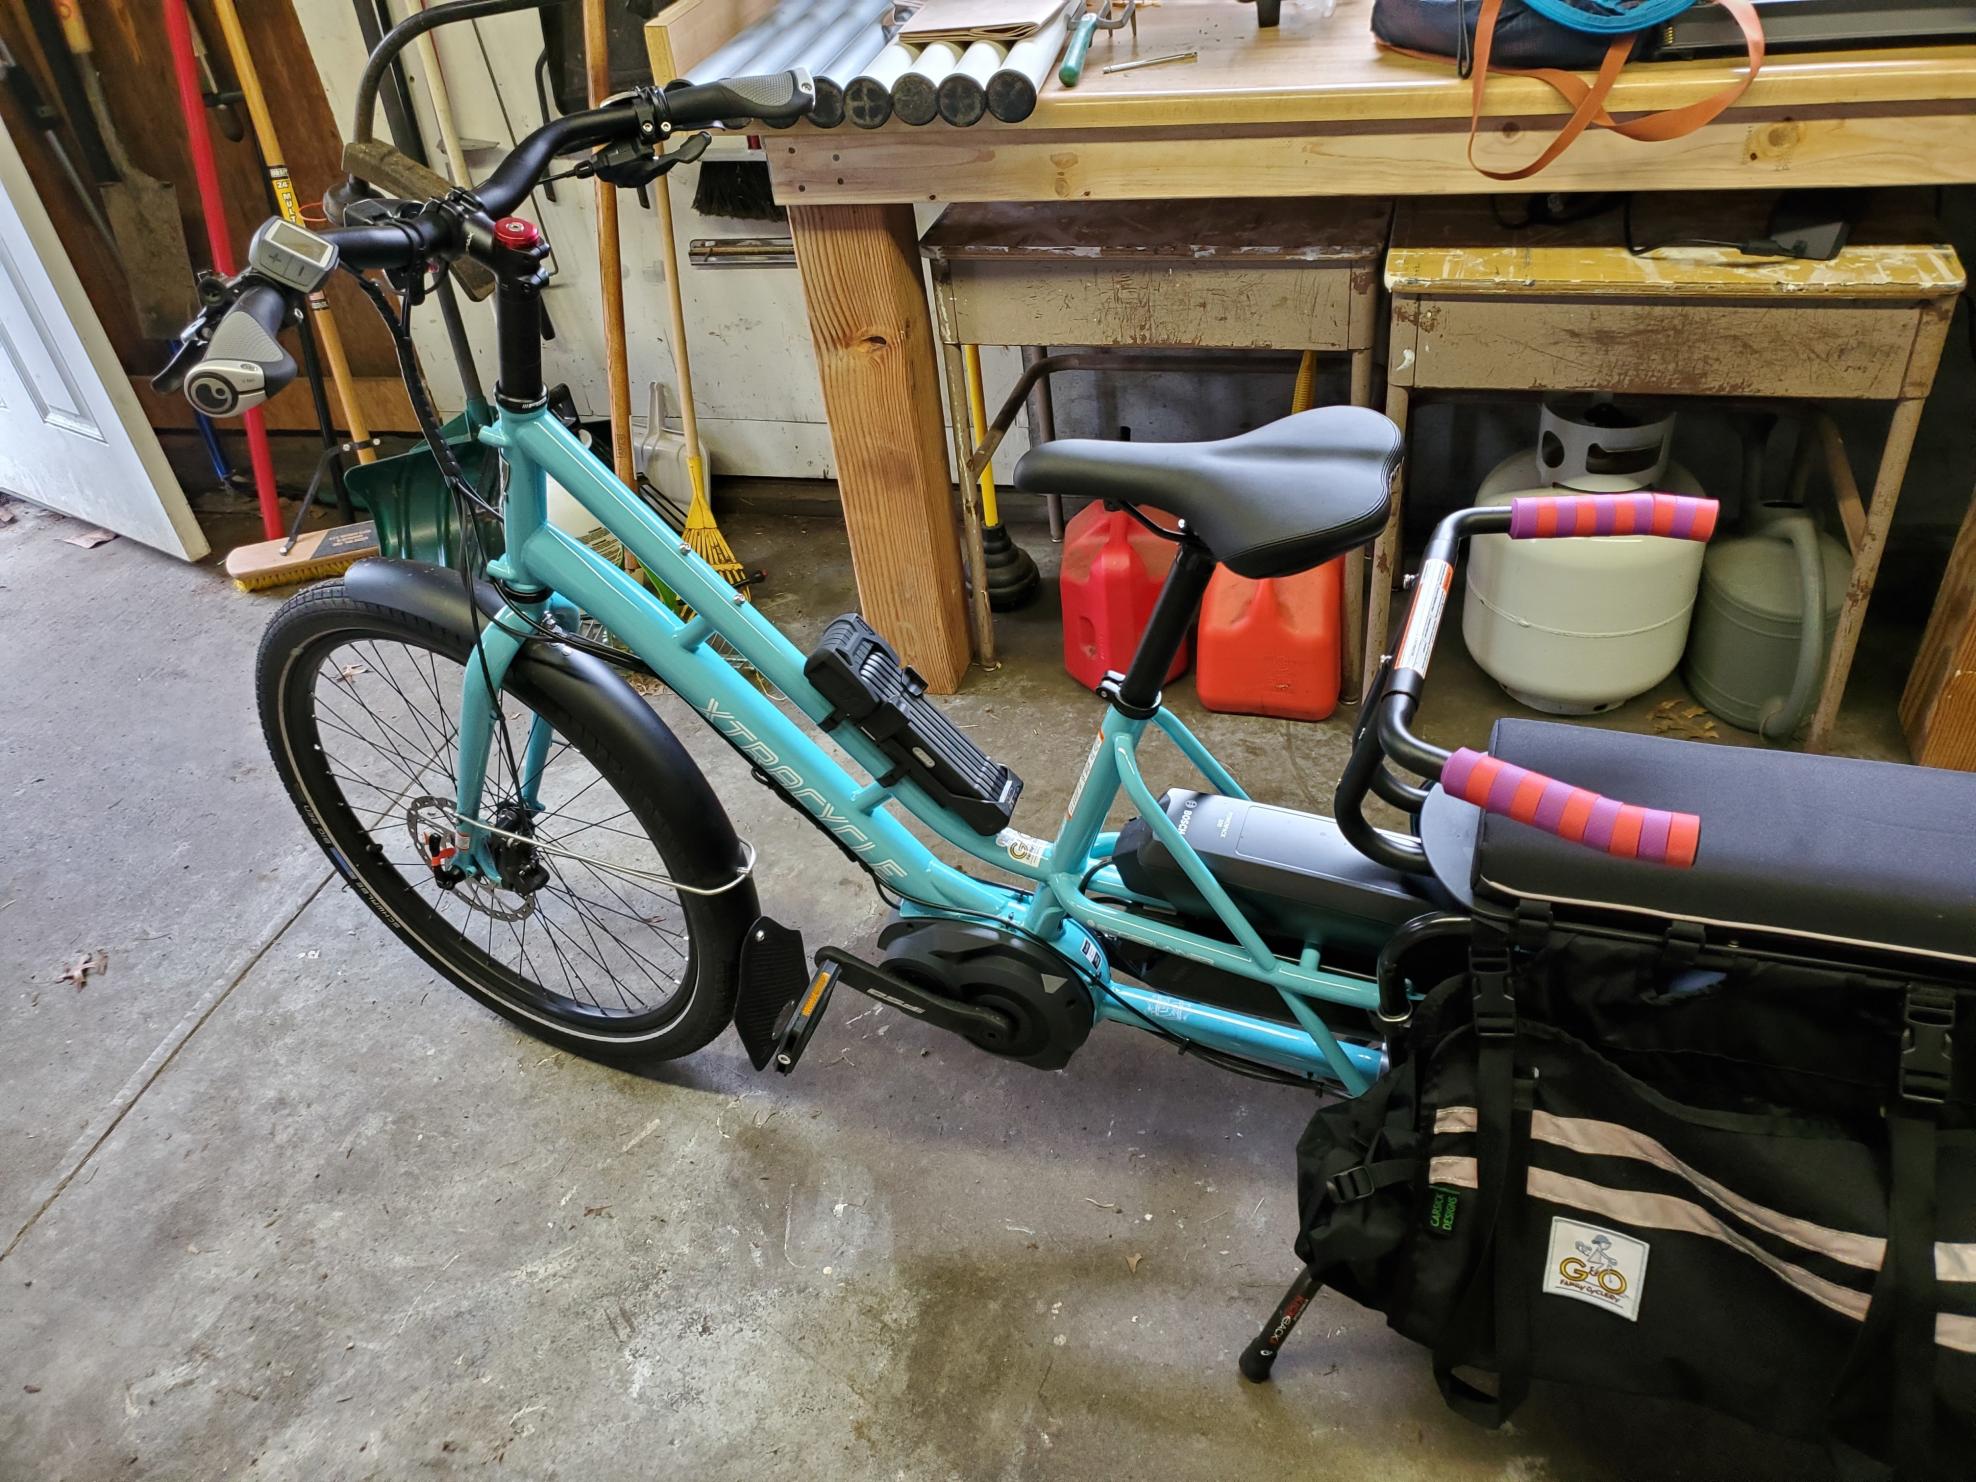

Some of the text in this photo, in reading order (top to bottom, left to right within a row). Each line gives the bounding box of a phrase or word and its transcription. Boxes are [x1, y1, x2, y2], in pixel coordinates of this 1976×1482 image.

[701, 698, 908, 879] XTRACYCLE
[1177, 809, 1193, 835] BOSCH
[355, 881, 401, 929] SCHWALBE
[1442, 1196, 1457, 1231] DESIGNS
